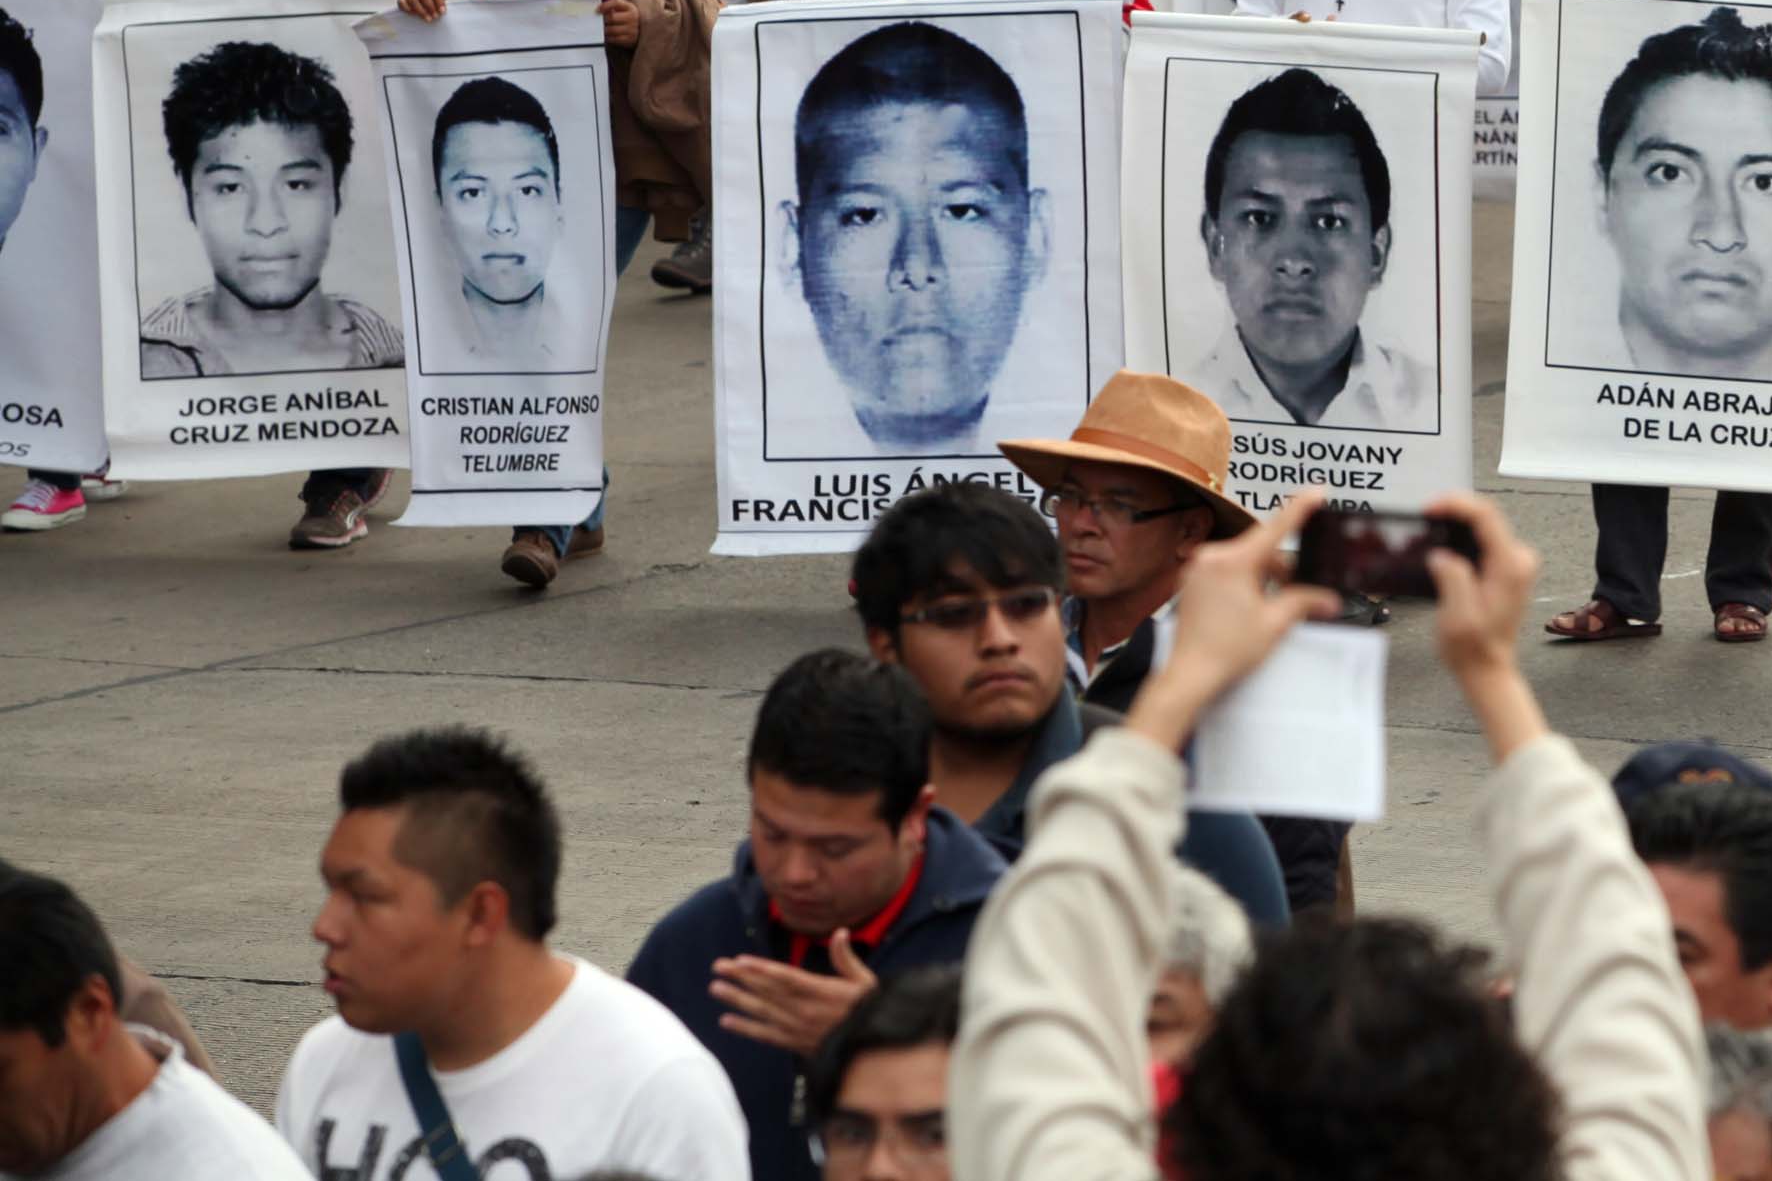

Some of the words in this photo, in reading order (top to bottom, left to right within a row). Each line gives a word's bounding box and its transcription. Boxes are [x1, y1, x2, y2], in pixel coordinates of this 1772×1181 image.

[179, 394, 277, 417] JORGE
[285, 387, 390, 411] ANÍBAL
[421, 397, 514, 416] CRISTIAN
[520, 394, 600, 416] ALFONSO
[1597, 382, 1675, 409] ADÁN
[0, 402, 64, 429] OSA
[170, 424, 250, 446] CRUZ
[258, 417, 400, 442] MENDOZA
[460, 422, 570, 445] RODRÍGUEZ
[1624, 417, 1660, 440] DE
[1668, 420, 1702, 443] LA
[1230, 432, 1287, 456] SÚS
[1292, 440, 1402, 466] JOVANY
[462, 453, 560, 473] TELUMBRE
[813, 474, 892, 498] LUIS
